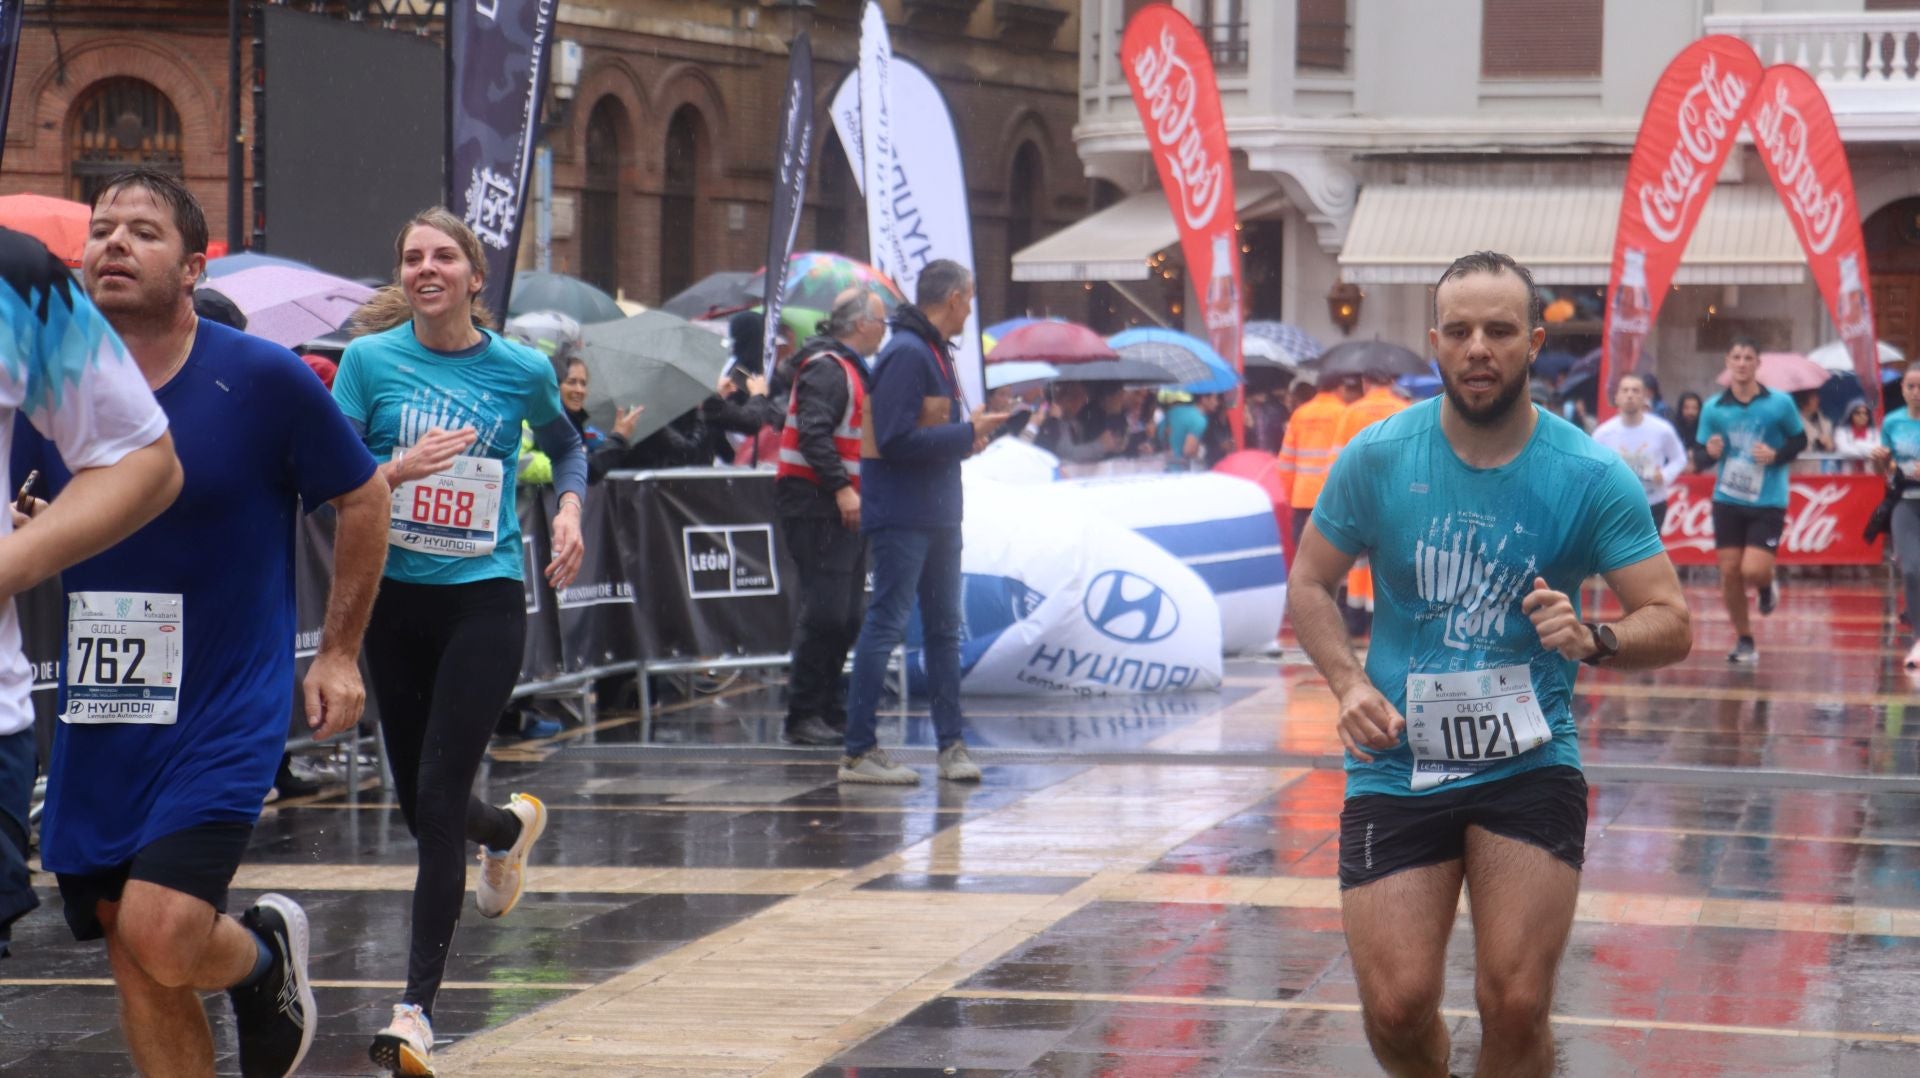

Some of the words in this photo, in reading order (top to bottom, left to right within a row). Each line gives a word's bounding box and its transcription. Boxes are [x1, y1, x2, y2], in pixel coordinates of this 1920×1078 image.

[1640, 52, 1746, 243] Coca-Cola
[439, 479, 454, 487] ANA
[412, 485, 475, 528] 668
[424, 536, 476, 550] HYUNDAI
[691, 548, 730, 572] LEÓN
[144, 611, 178, 619] kutxabank
[91, 623, 128, 635] GUILLE
[40, 661, 53, 681] DE
[77, 636, 146, 685] 762
[1028, 644, 1199, 693] HYUNDAI
[87, 702, 155, 714] HYUNDAI
[1456, 702, 1494, 714] CHUCHO
[1440, 712, 1520, 760] 1021
[1365, 822, 1374, 869] SALOMON
